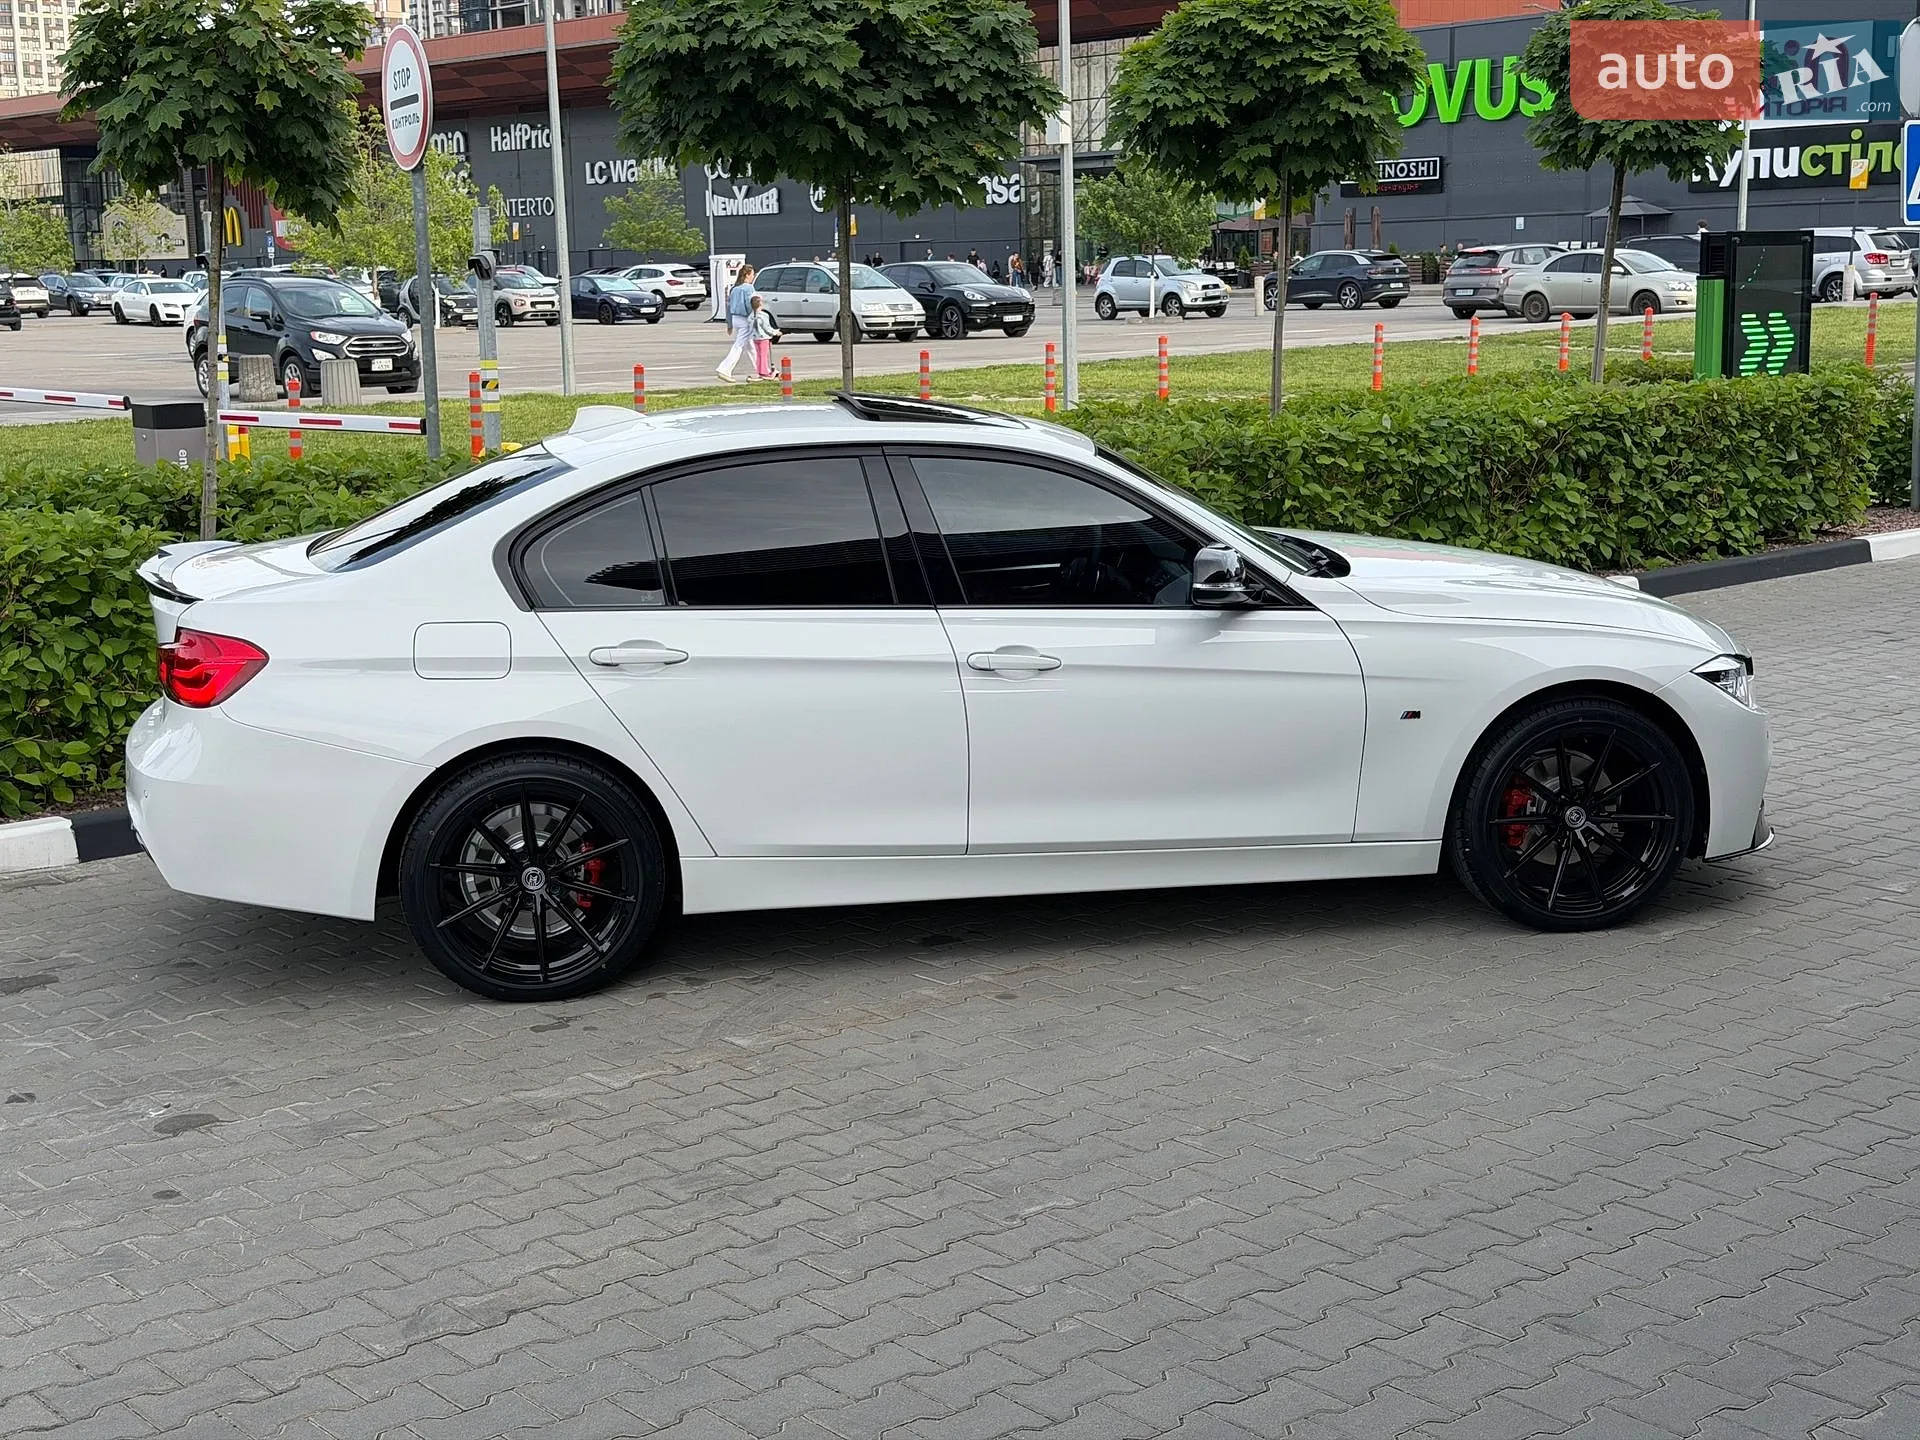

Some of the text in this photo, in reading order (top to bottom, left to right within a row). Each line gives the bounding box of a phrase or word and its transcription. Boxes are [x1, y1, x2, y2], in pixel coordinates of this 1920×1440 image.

[392, 67, 411, 91] STOP
[1382, 56, 1558, 128] OVUS
[392, 112, 420, 130] КОНТРОЛЬ
[490, 123, 552, 152] HalfPric
[585, 162, 607, 185] LC
